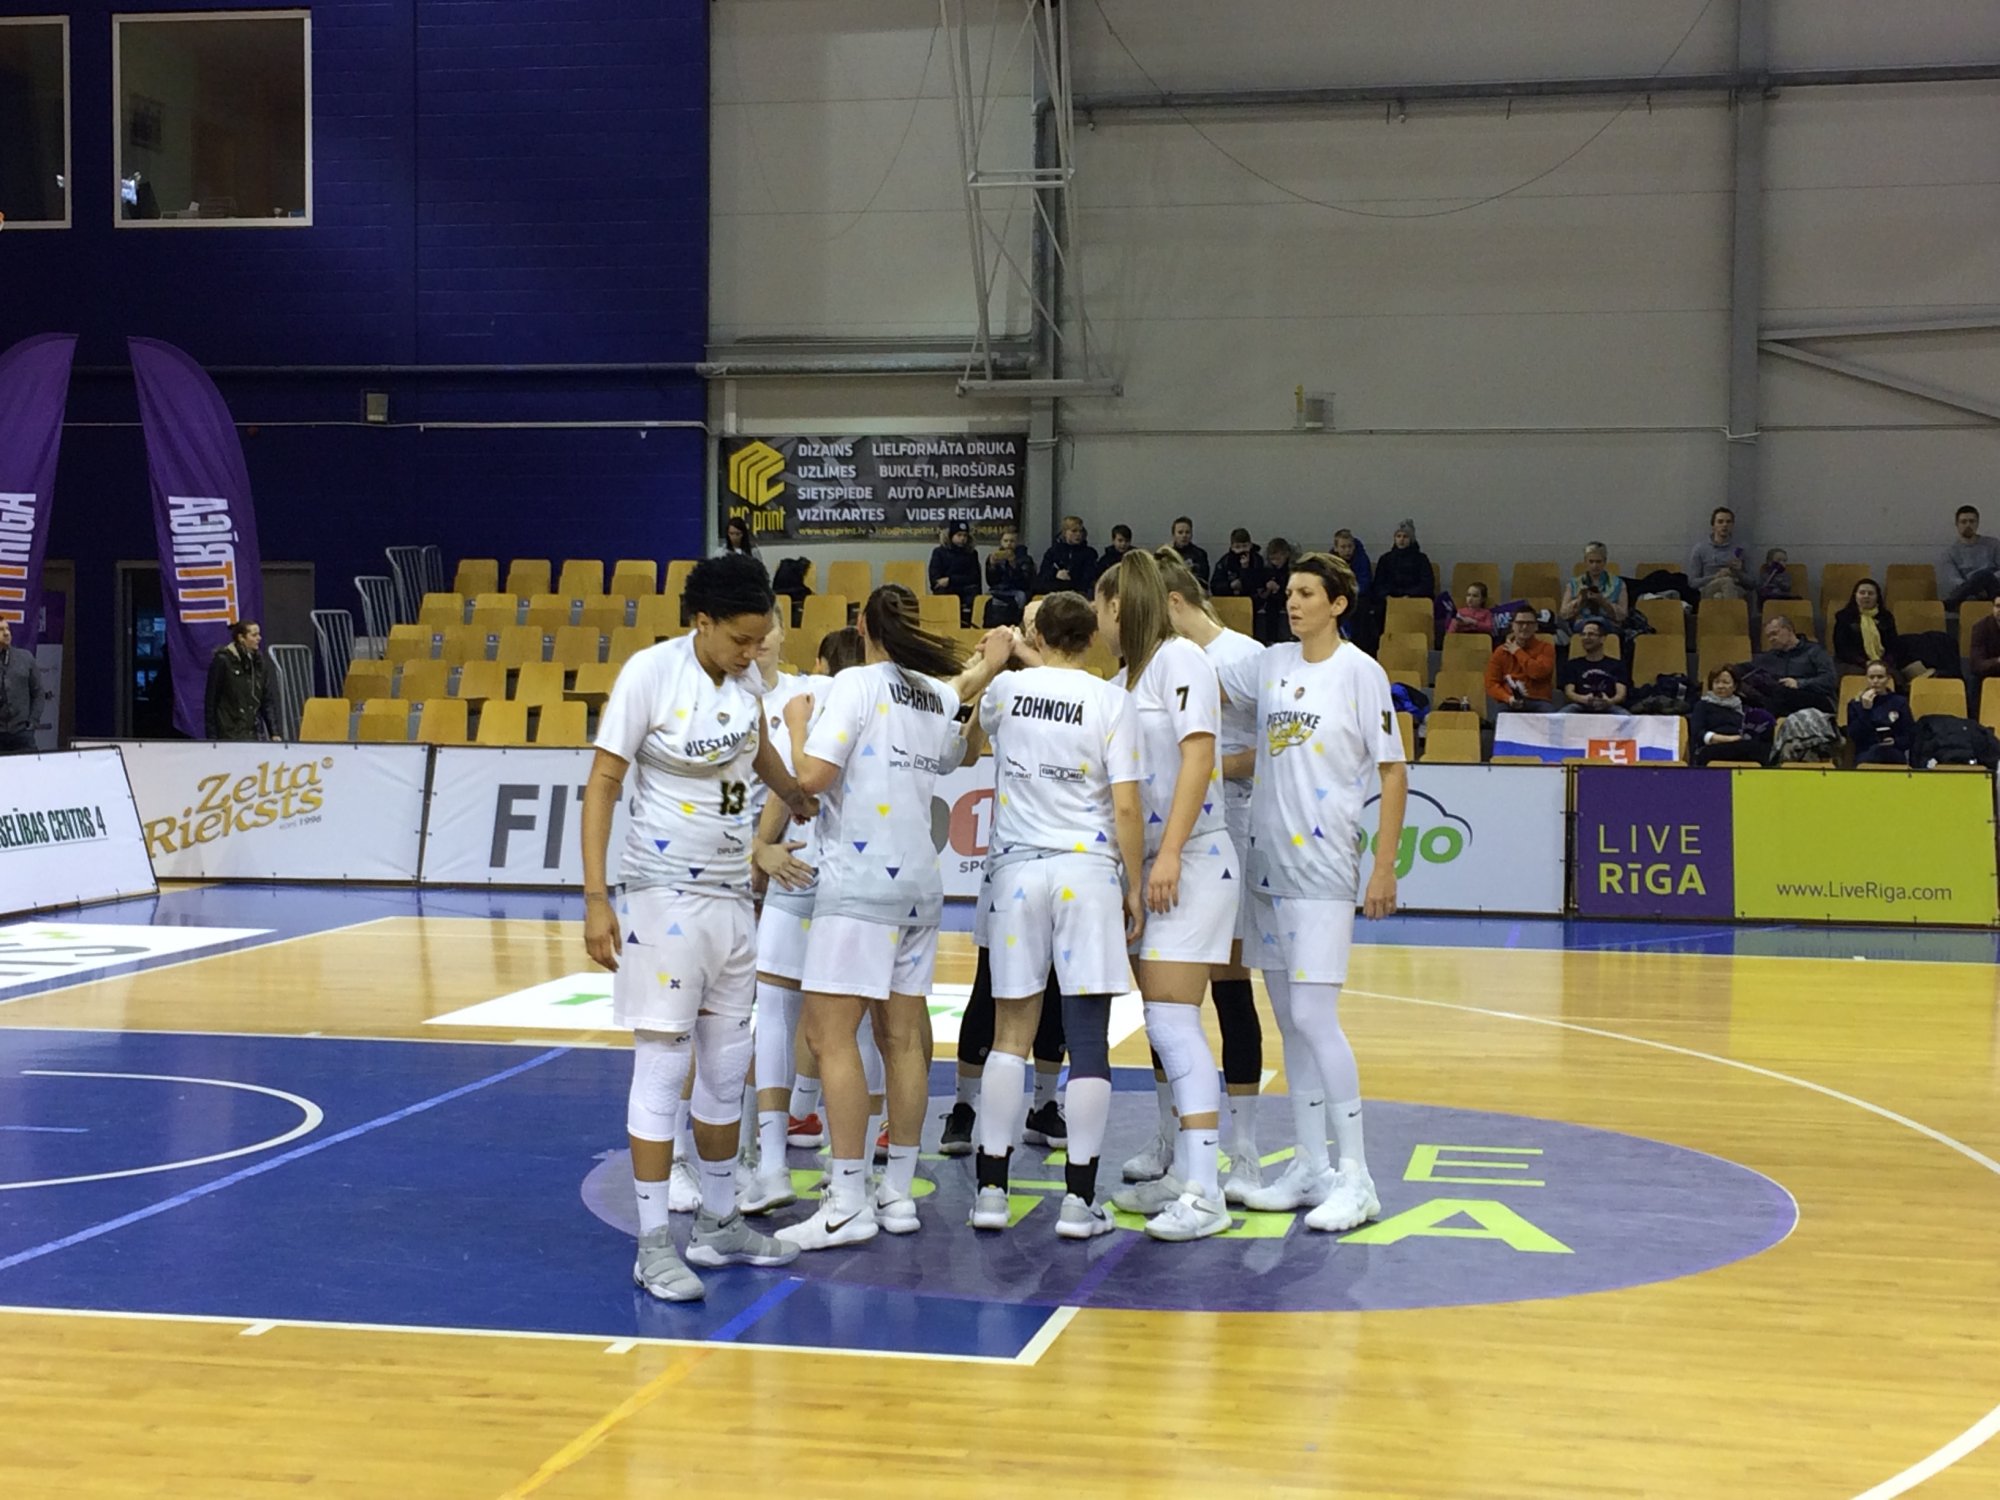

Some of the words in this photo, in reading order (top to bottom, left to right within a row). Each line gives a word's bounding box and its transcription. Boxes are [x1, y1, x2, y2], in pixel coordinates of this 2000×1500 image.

[798, 443, 853, 457] DIZAINS
[872, 440, 964, 456] LIELFORMĀTA
[967, 442, 1016, 455] DRUKA
[798, 463, 857, 478] UZLĪMES
[942, 462, 1015, 477] BROŠŪRAS
[797, 486, 873, 500] SIETSPIEDE
[887, 486, 924, 499] AUTO
[927, 483, 1015, 499] APLĪMĒŠANA
[752, 505, 787, 536] print
[796, 506, 885, 521] VIZĪTKARTES
[906, 508, 945, 521] VIDES
[948, 505, 1014, 520] REKLĀMA
[1176, 685, 1190, 712] 7
[1011, 695, 1085, 728] ZOHNOVÁ
[719, 780, 747, 816] 13
[47, 806, 96, 842] CENTRS
[95, 805, 107, 836] 4
[144, 787, 323, 858] Rieksts
[1599, 824, 1701, 854] LIVE
[1776, 881, 1952, 903] www.LiveRiga.com
